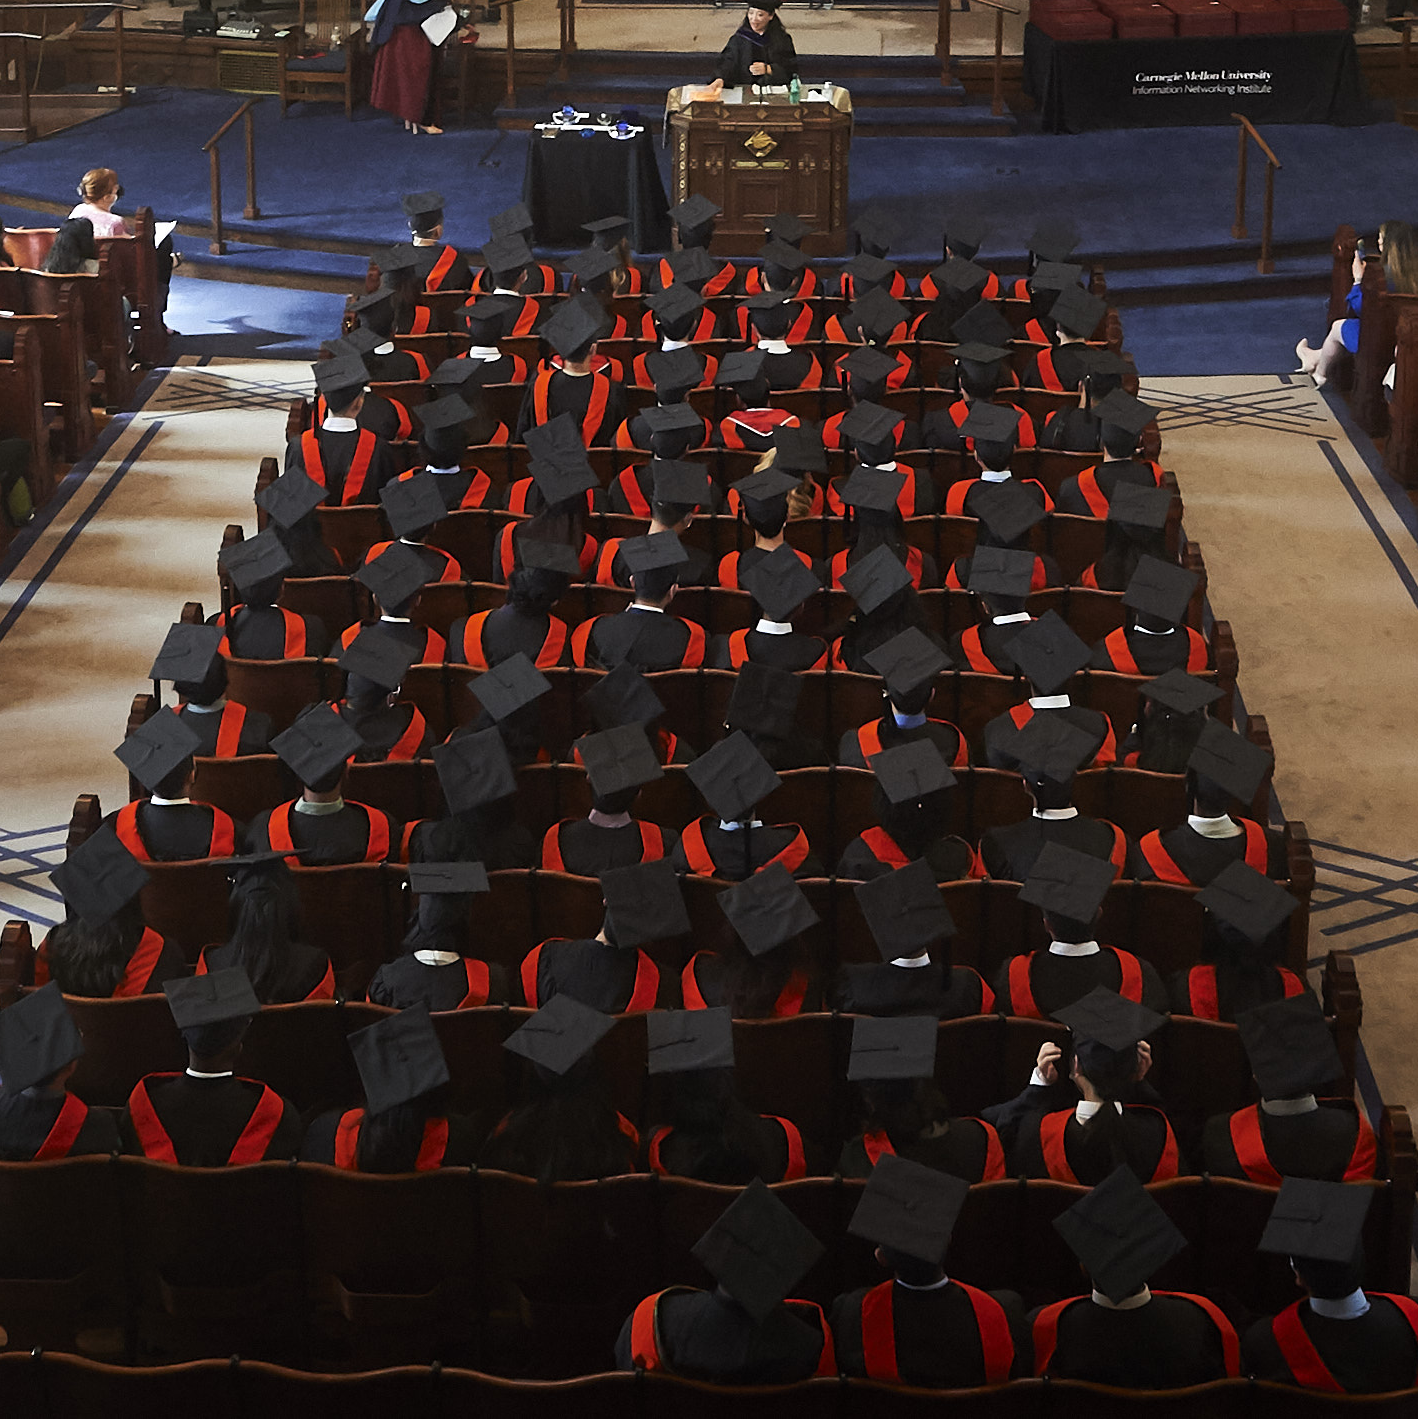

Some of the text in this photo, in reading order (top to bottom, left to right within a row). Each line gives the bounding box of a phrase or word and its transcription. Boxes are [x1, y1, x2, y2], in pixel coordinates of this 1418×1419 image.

[1135, 70, 1272, 83] Carnegie Mellon University
[1132, 84, 1272, 95] Information Networking Institute
